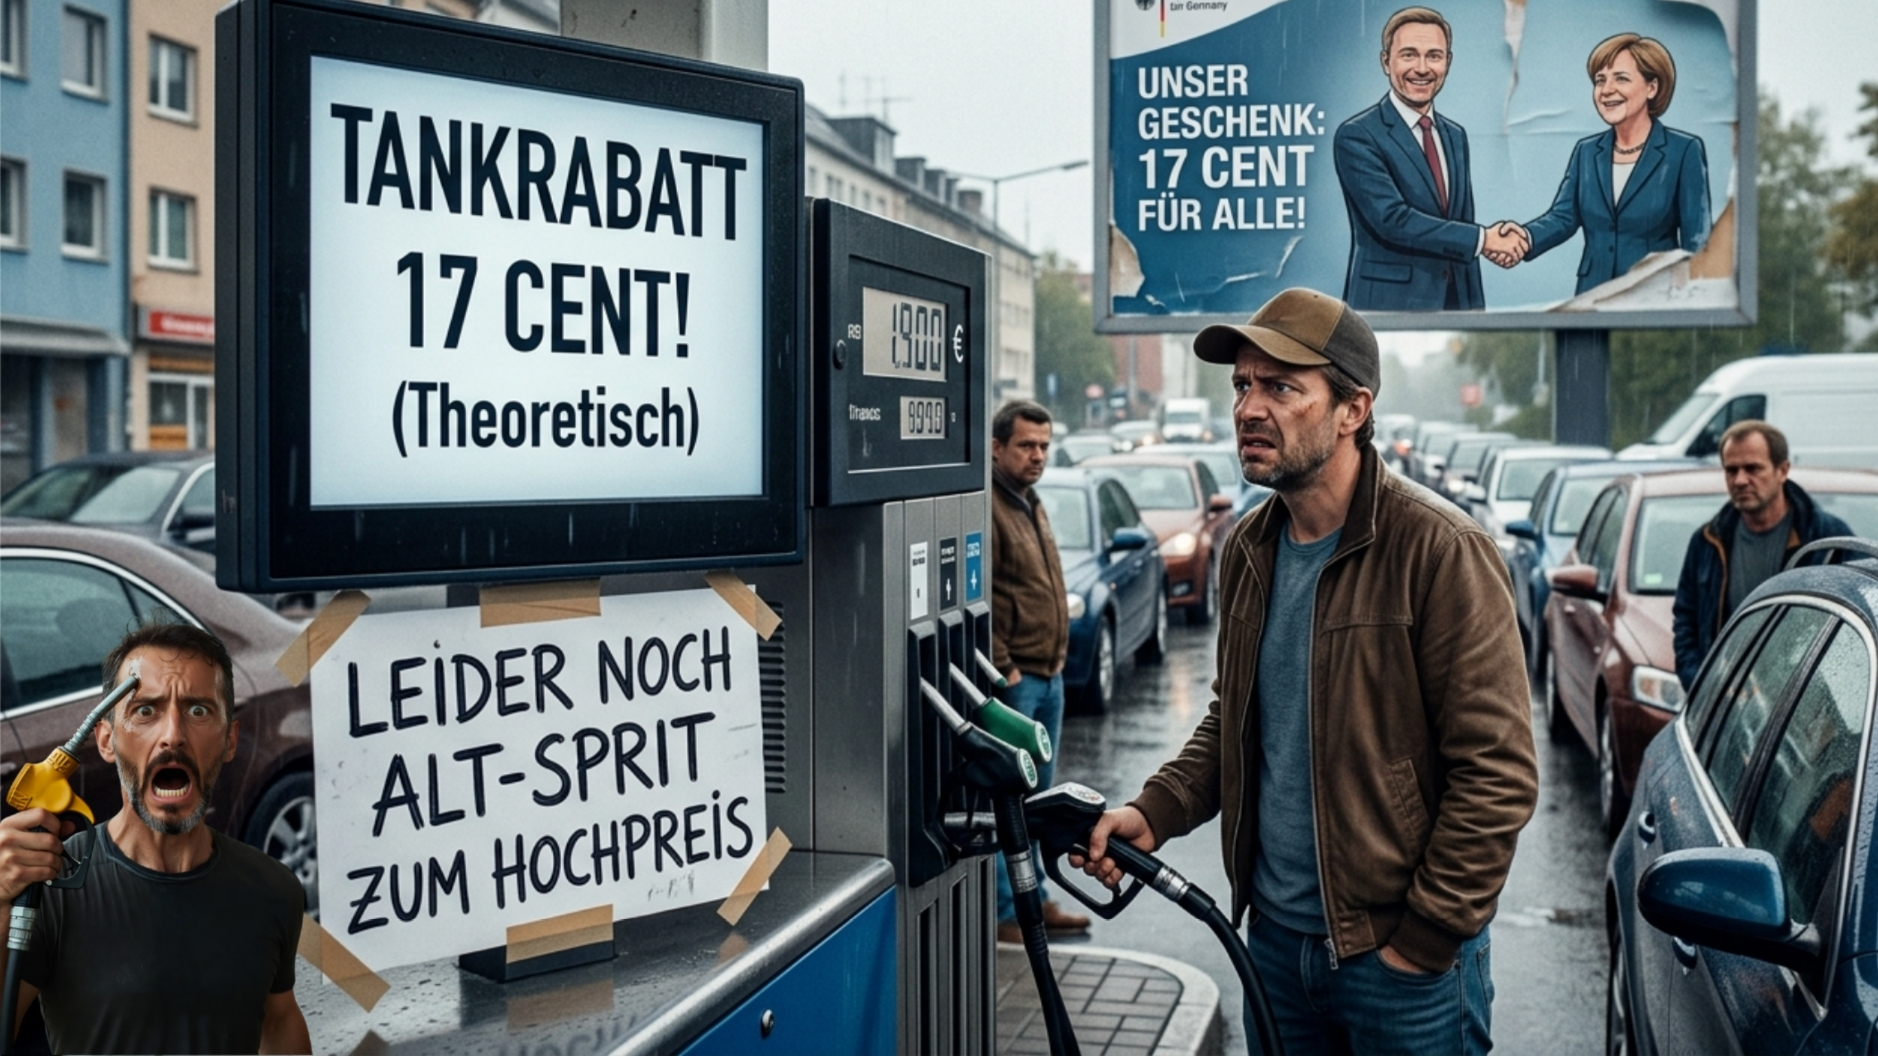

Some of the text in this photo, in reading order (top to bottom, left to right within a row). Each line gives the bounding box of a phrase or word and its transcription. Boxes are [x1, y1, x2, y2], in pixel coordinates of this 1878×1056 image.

[1138, 64, 1249, 99] UNSER
[1138, 103, 1326, 139] GESCHENK:
[330, 102, 747, 241] TANKRABATT
[1138, 145, 1316, 189] 17 CENT
[1138, 192, 1306, 231] FÜR ALLE!
[396, 251, 691, 359] 17 CENT!
[392, 380, 700, 458] (Theoretisch)
[348, 626, 732, 738] LEIDER NOCH
[372, 712, 716, 837] ALT-SPRIT
[346, 790, 754, 936] ZUM HOCHPREIS
